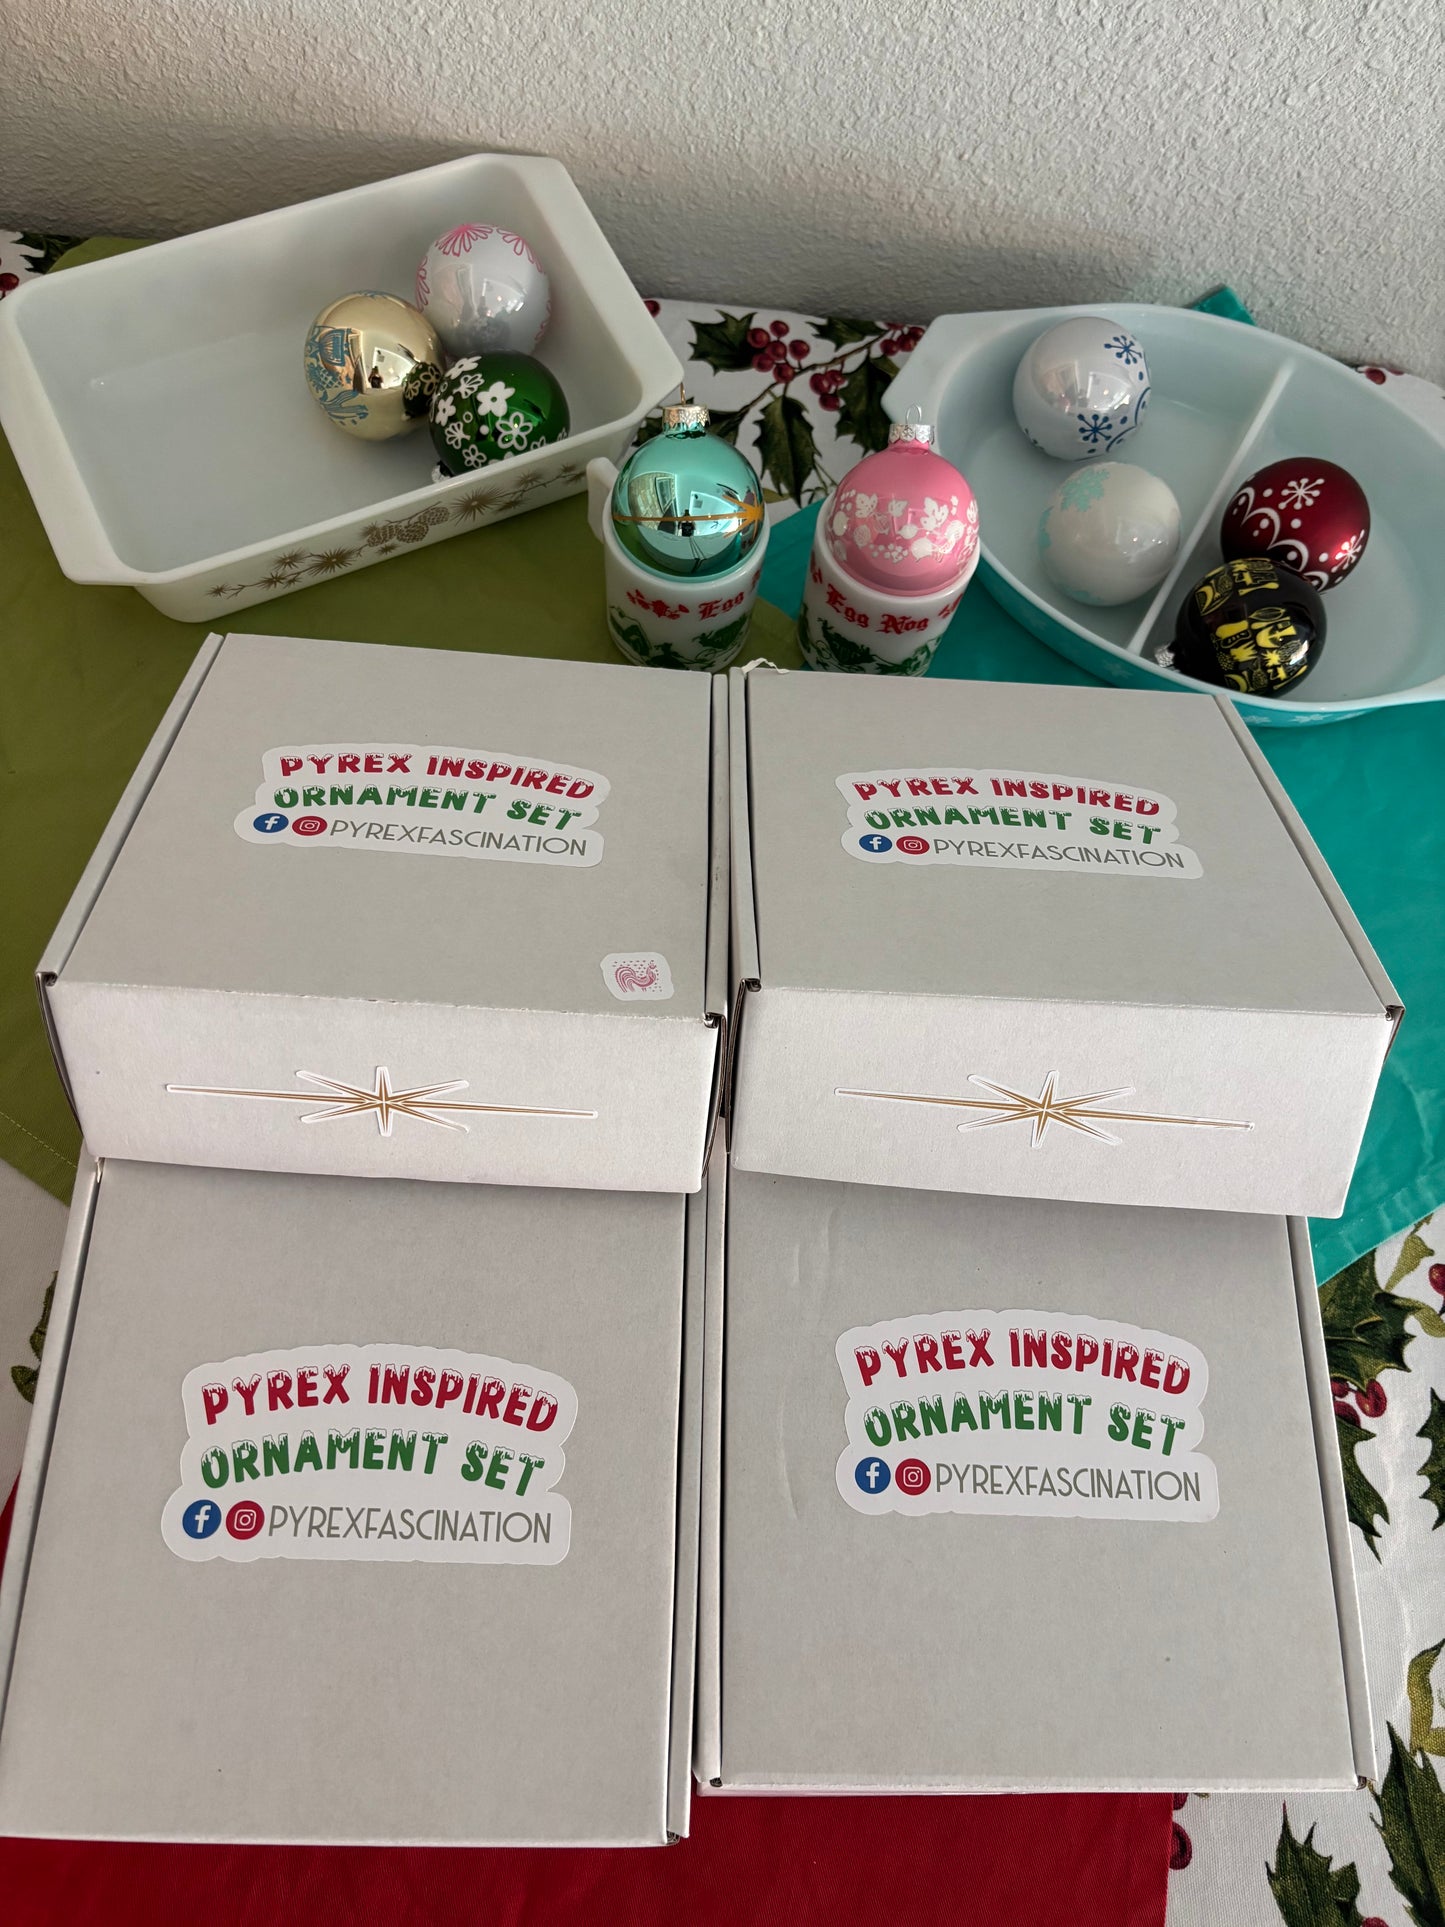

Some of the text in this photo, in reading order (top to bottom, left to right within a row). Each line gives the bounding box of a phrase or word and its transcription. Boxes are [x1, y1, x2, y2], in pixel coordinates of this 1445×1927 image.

[826, 584, 930, 635] Egg Nog
[280, 752, 595, 799] PYREX INSPIRED
[852, 776, 1160, 817] PYREX INSPIRED
[274, 784, 583, 831] ORNAMENT SET
[864, 805, 1163, 845] ORNAMENT SET
[330, 819, 587, 857] PYREXFASCINATION
[934, 839, 1185, 869] PYREXFASCINATION
[854, 1328, 1190, 1395] PYREX INSPIRED
[201, 1363, 559, 1432] PYREX INSPIRED
[863, 1390, 1186, 1456] ORNAMENT SET
[201, 1427, 545, 1496] ORNAMENT SET
[936, 1464, 1201, 1501] PYREXFASCINATION
[268, 1505, 551, 1544] PYREXFASCINATION
